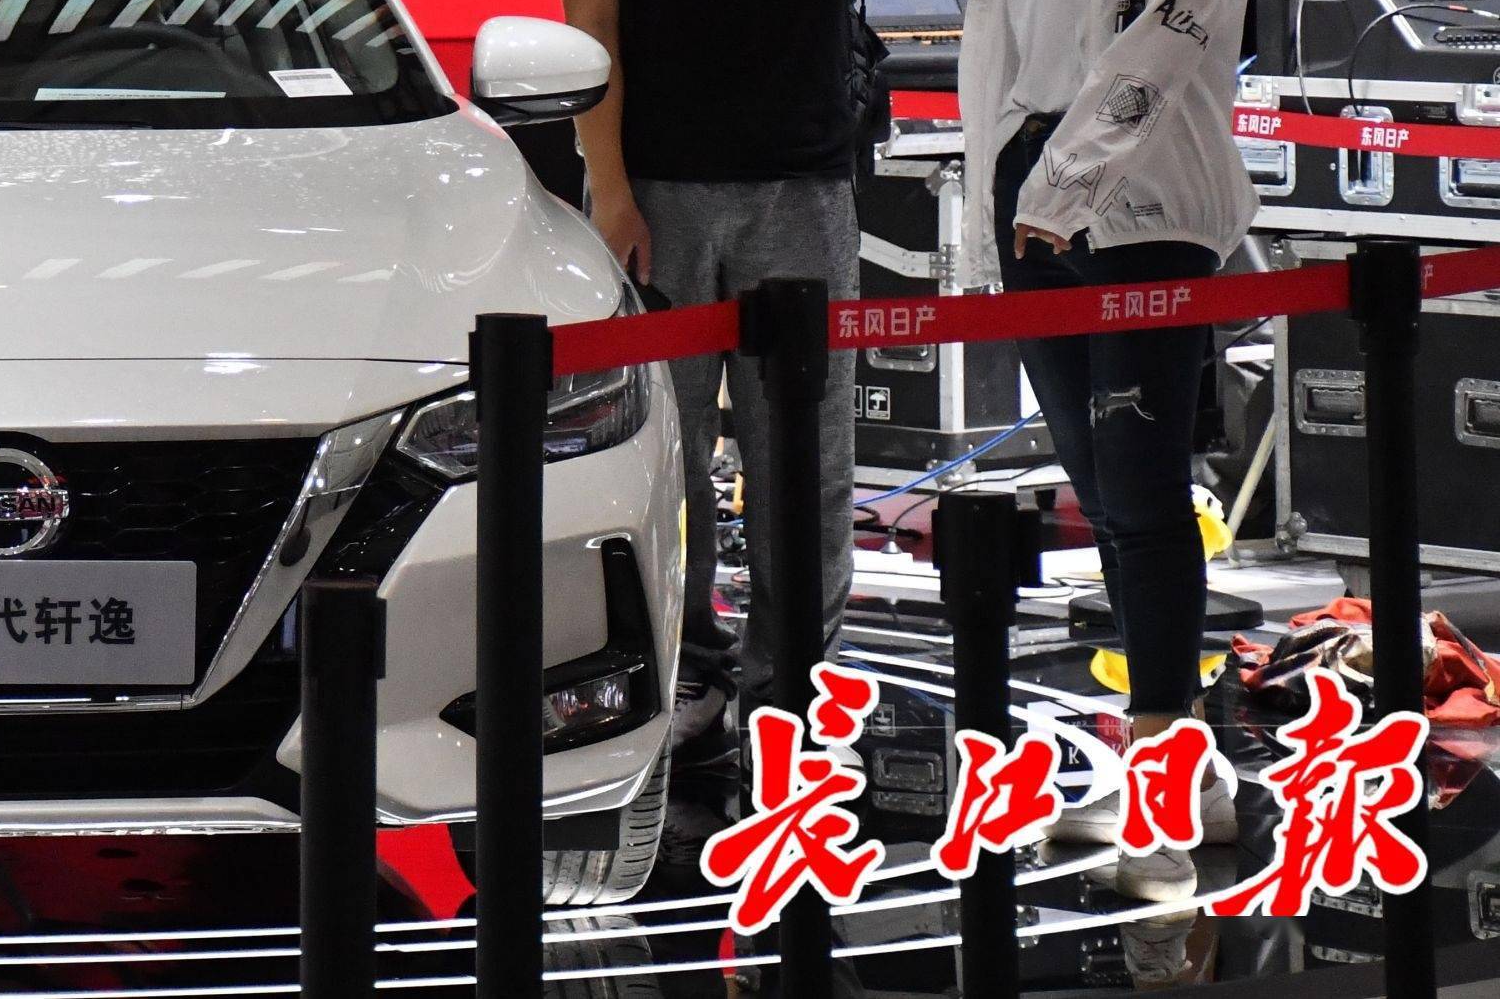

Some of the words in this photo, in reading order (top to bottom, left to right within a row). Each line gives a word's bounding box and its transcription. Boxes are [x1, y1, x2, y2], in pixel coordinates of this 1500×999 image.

[1236, 113, 1282, 136] 东风日产
[1360, 126, 1410, 149] 东风日产
[1101, 286, 1192, 321] 东风日产
[838, 304, 936, 338] 东风日产
